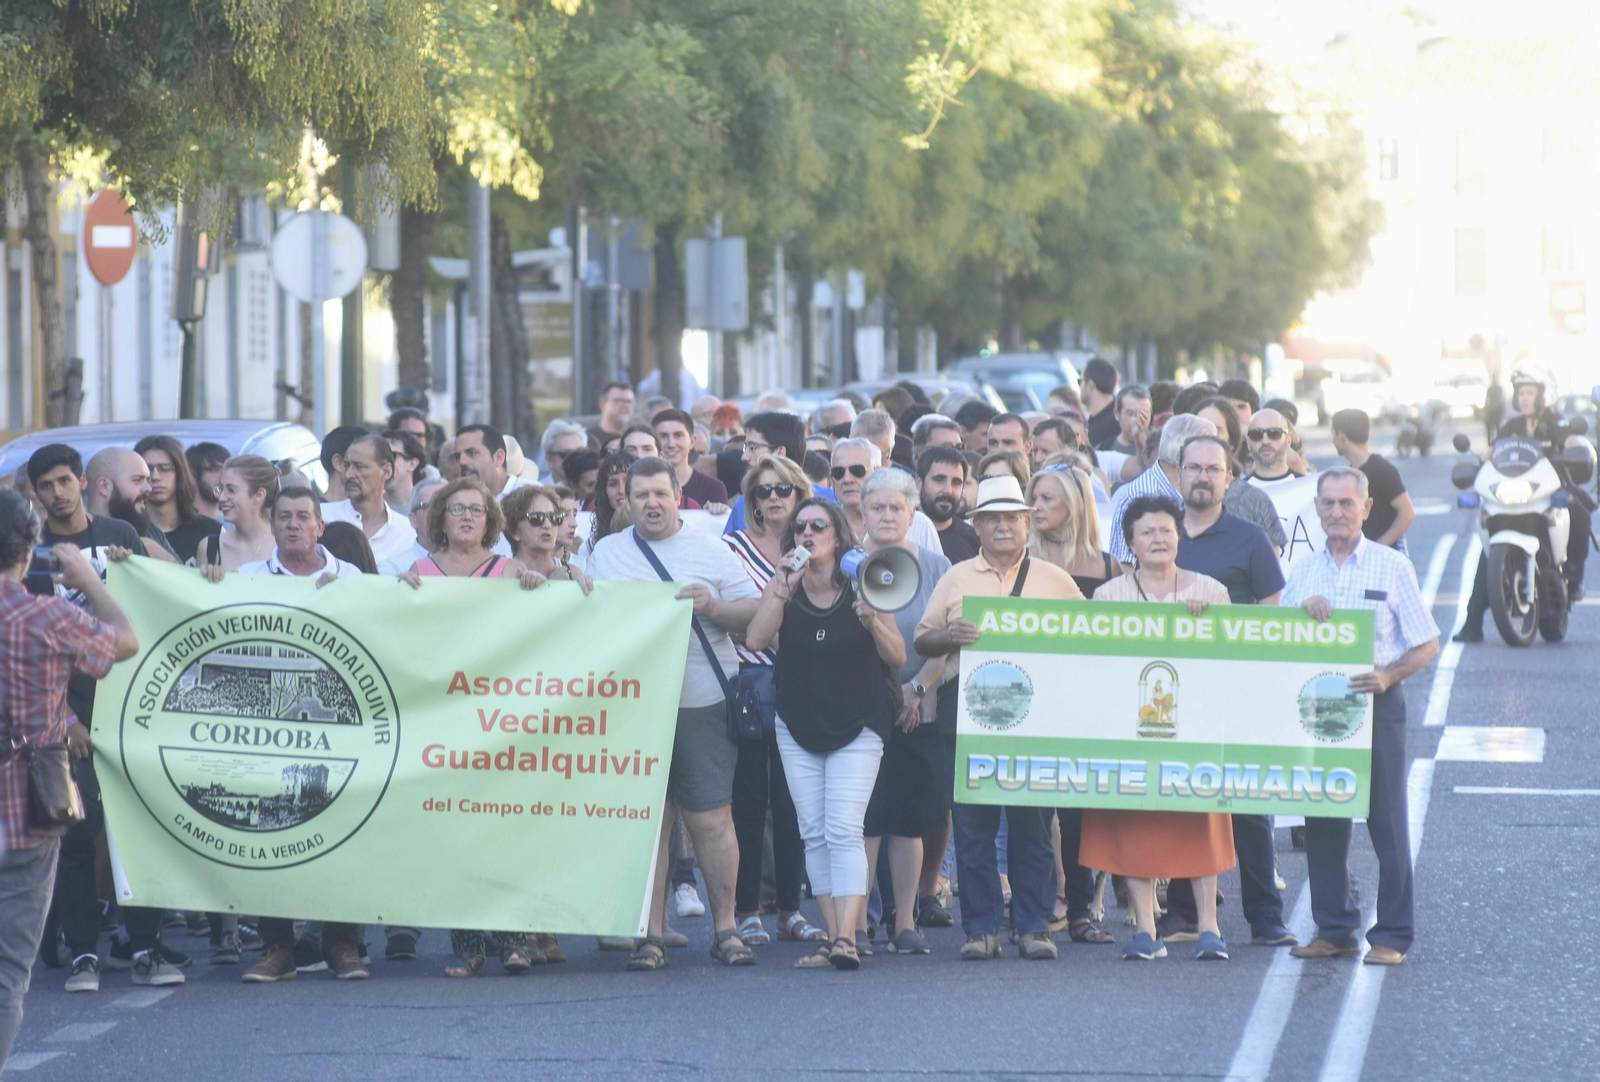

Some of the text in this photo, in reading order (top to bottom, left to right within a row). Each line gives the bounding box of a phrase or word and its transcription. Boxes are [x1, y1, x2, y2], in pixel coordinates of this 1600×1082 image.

[979, 611, 1357, 645] ASOCIACION DE VECINOS
[134, 614, 391, 745] ASOCIACIÓN VECINAL GUADALQUIVIR
[446, 670, 641, 699] Asociación
[189, 721, 332, 751] CORDOBA
[476, 708, 607, 736] Vecinal
[421, 743, 659, 780] Guadalquivir
[966, 753, 1357, 803] PUENTE ROMANO
[422, 797, 651, 820] del Campo de la Verdad
[174, 813, 325, 860] CAMPO DE LA VERDAD
